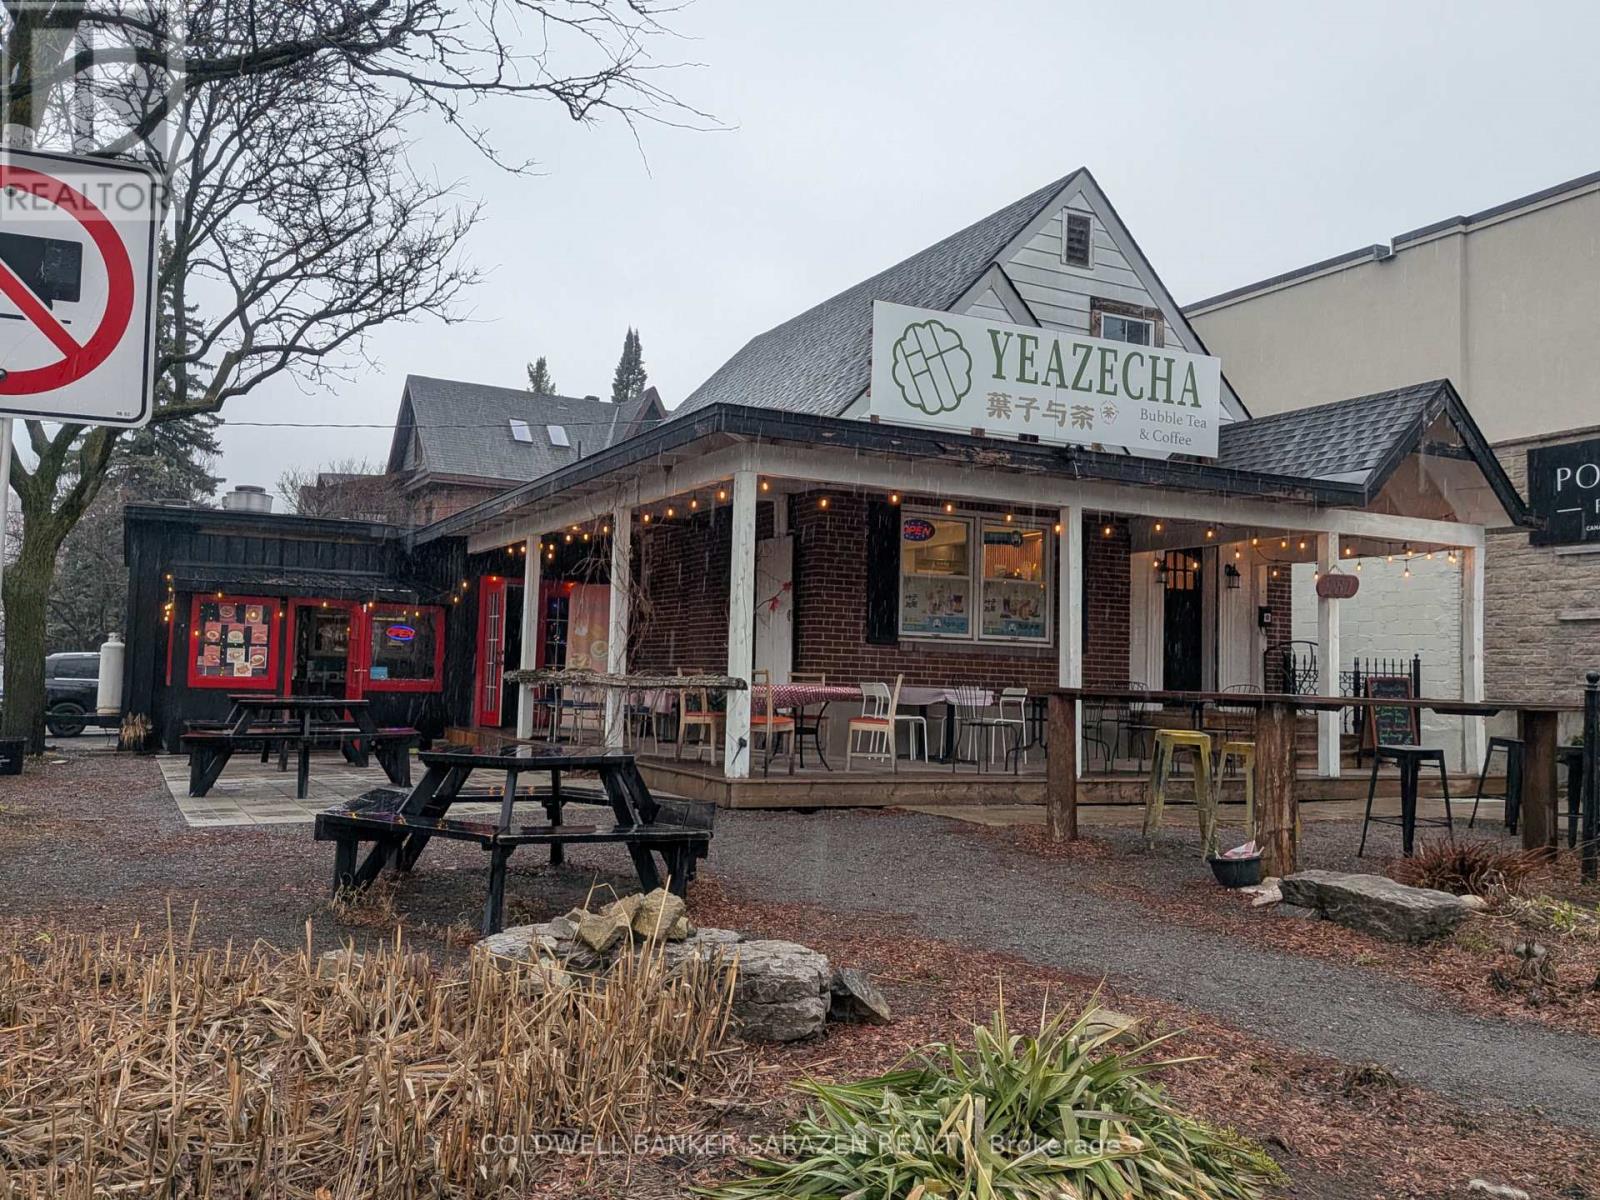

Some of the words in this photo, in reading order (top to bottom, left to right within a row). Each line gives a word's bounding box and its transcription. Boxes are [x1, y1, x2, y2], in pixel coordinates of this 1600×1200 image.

[987, 328, 1202, 409] YEAZECHA
[986, 391, 1095, 431] 葉子与茶
[1140, 407, 1183, 426] Bubble
[1185, 414, 1207, 429] Tea
[1139, 428, 1150, 441] &
[1152, 429, 1192, 446] Coffee
